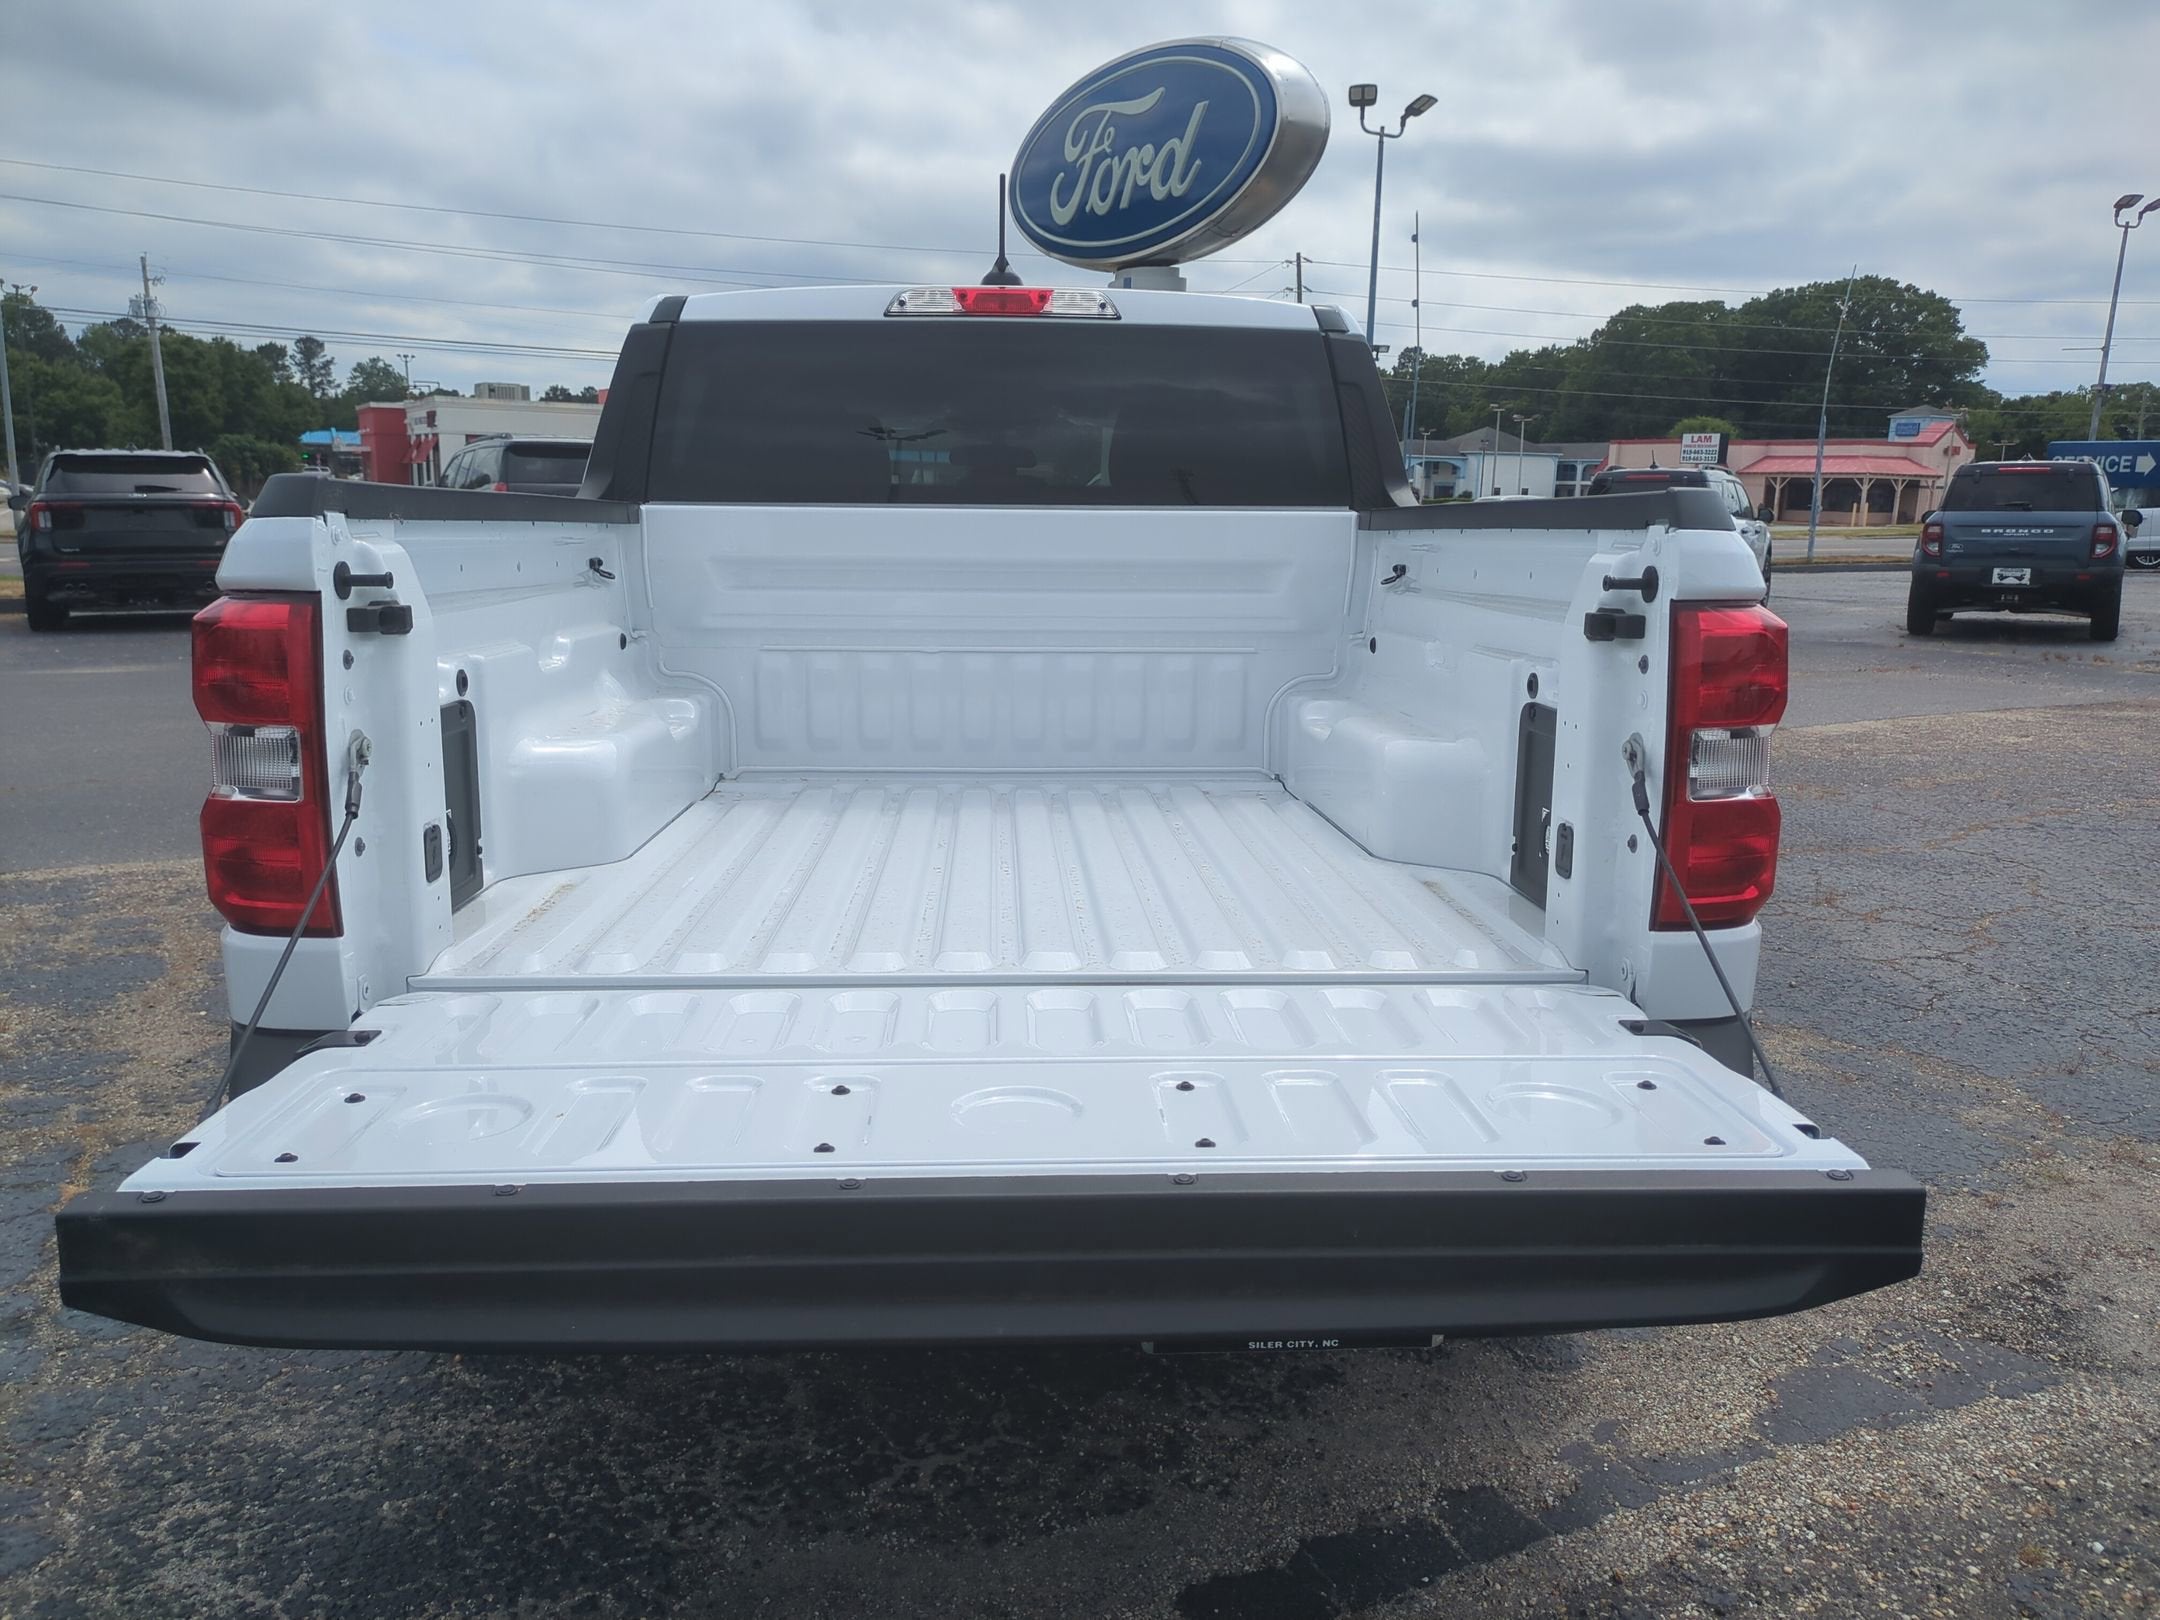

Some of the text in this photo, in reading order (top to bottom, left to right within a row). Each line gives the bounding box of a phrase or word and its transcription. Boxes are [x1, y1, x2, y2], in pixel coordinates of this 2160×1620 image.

[1050, 86, 1209, 226] Ford
[1691, 435, 1712, 443] LAM
[1248, 1339, 1339, 1349] SILER CITY, NC
